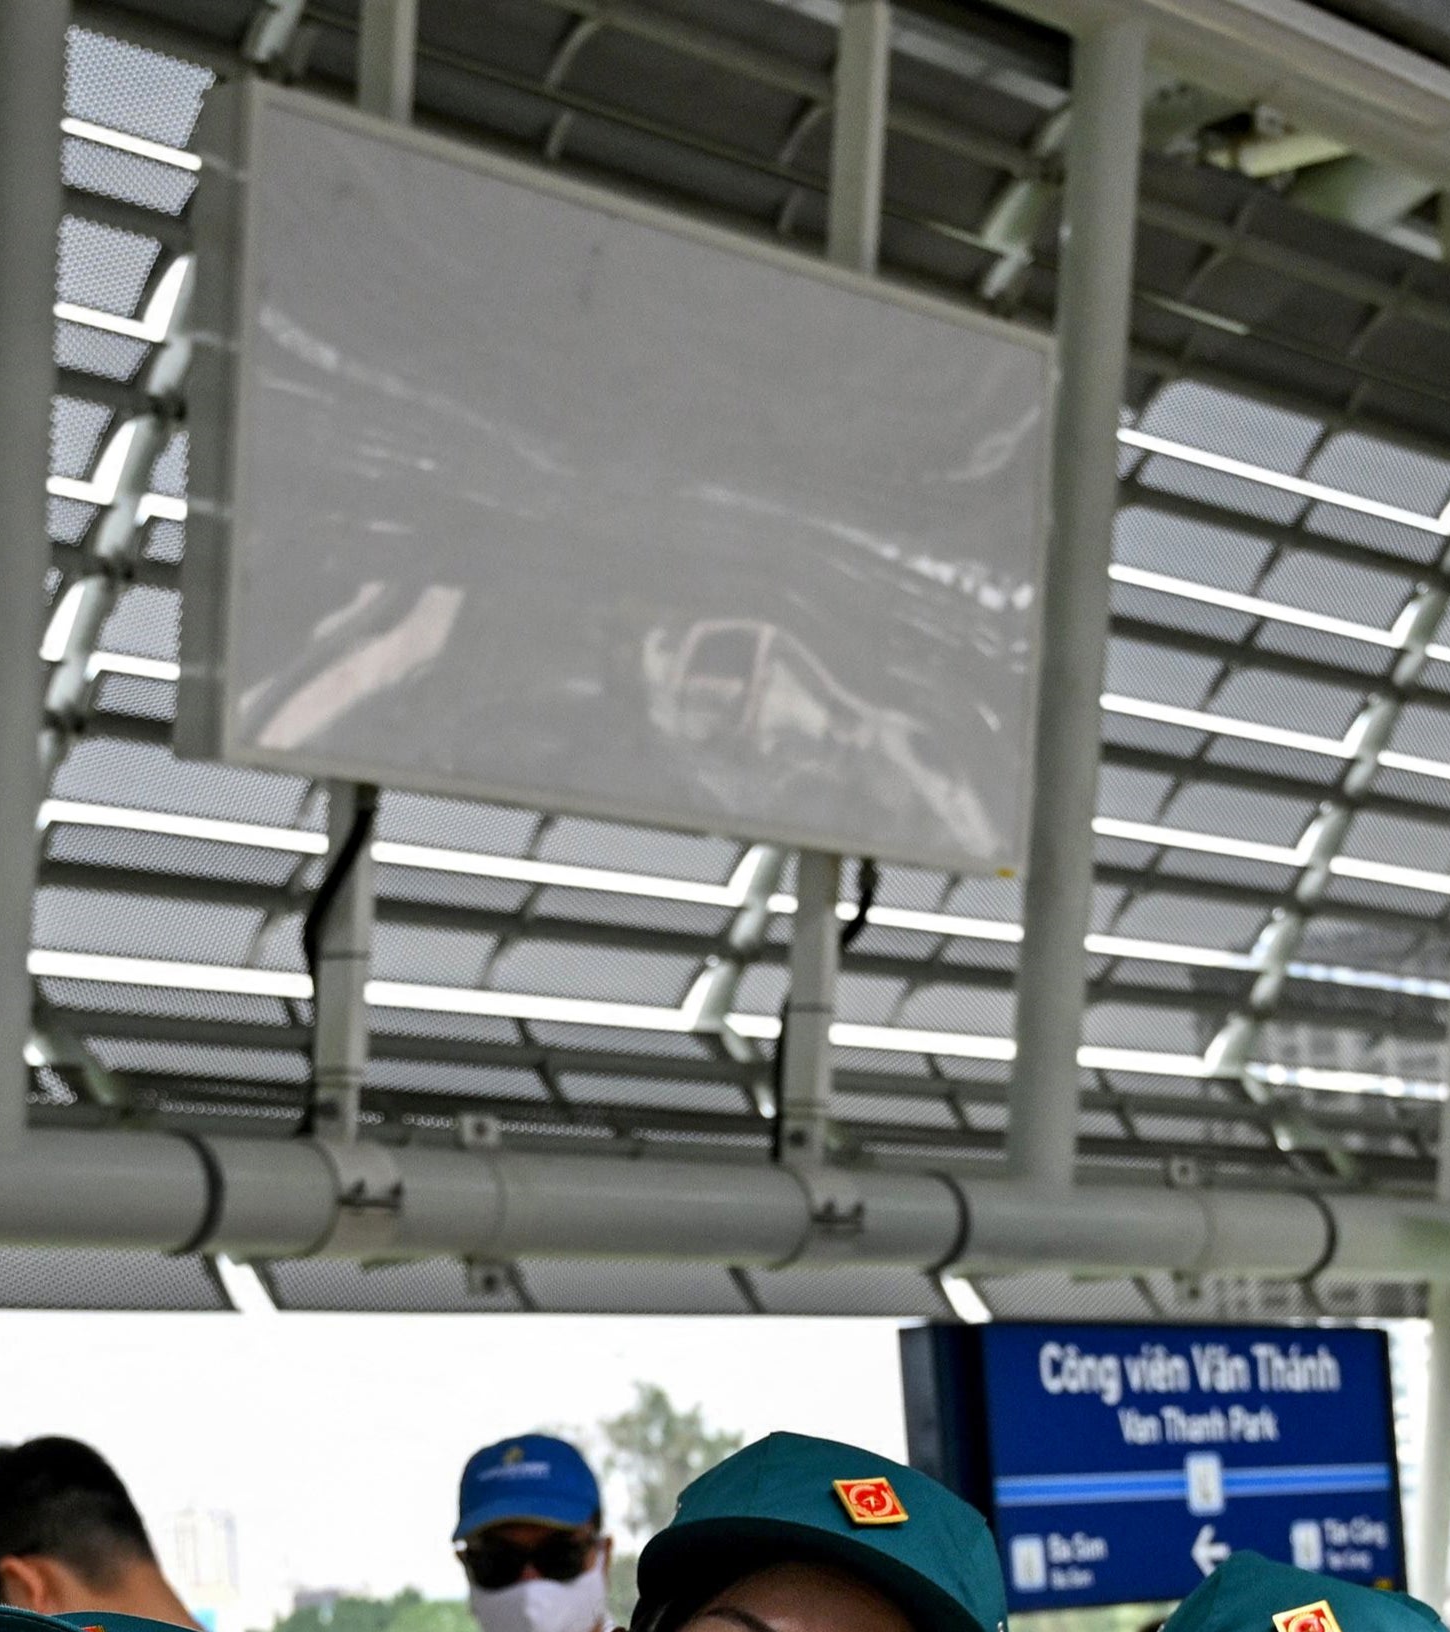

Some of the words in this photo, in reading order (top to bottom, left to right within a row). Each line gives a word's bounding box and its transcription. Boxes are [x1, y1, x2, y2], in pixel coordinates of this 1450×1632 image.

[1039, 1341, 1122, 1405] Công
[1123, 1342, 1191, 1393] viên
[1250, 1342, 1341, 1392] Thánh
[1117, 1406, 1163, 1445] Van
[1160, 1405, 1228, 1443] Thanh
[1228, 1404, 1280, 1443] Park
